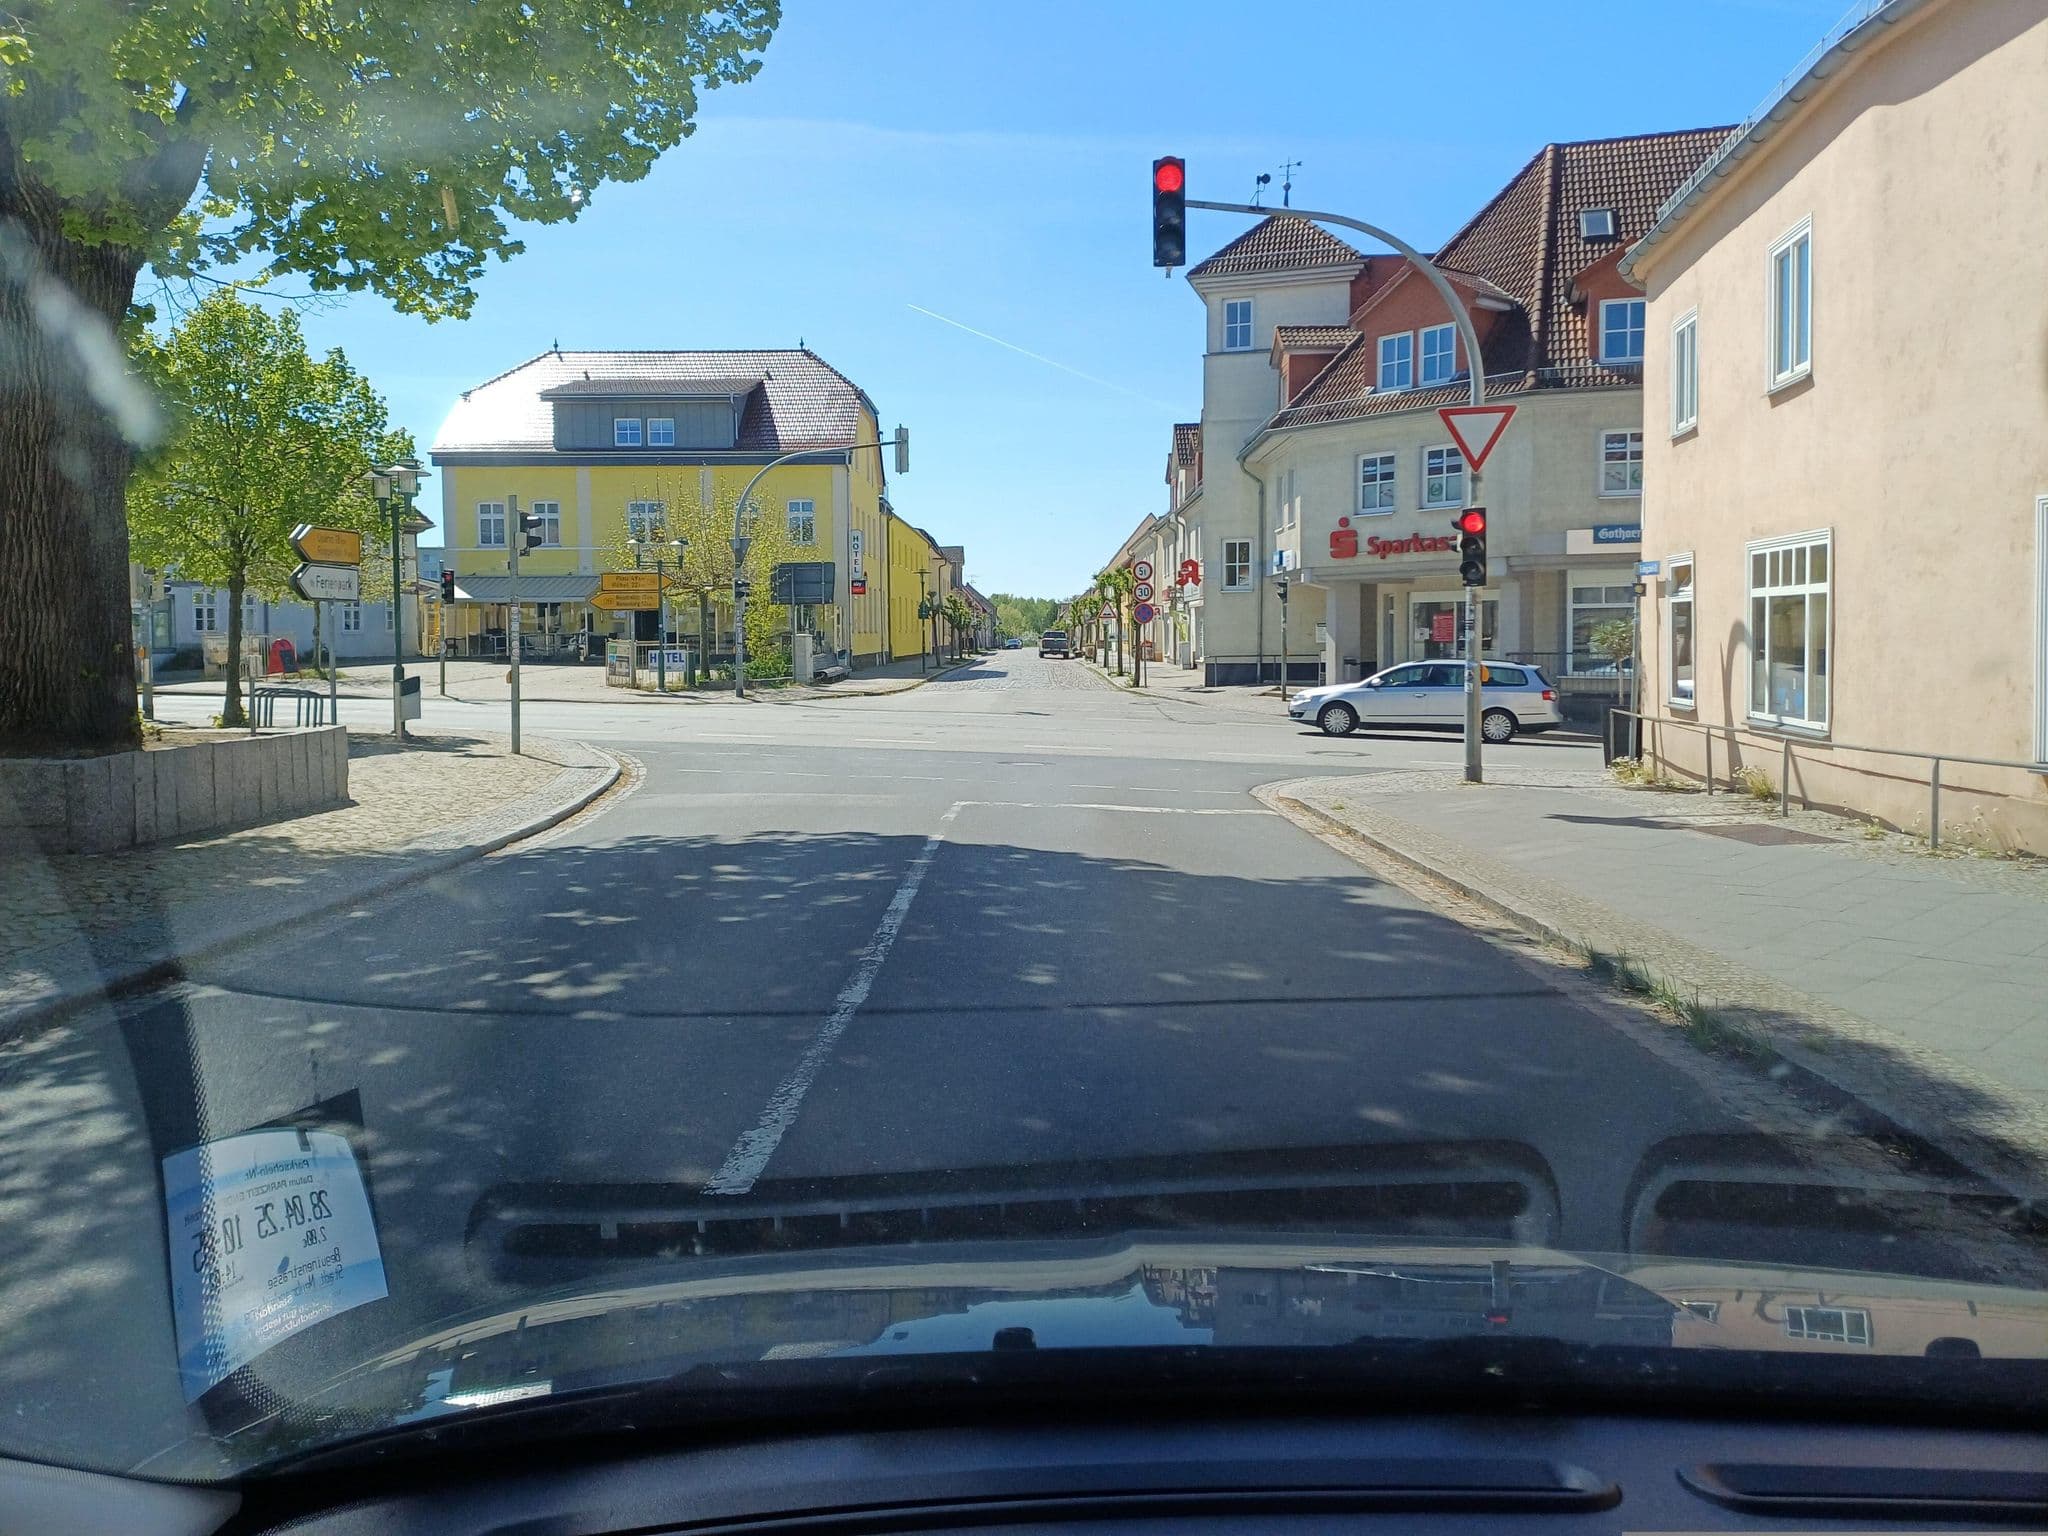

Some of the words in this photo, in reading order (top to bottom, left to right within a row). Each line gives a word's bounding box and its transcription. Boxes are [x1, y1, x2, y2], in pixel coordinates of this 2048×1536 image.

[852, 535, 860, 573] HOTEL
[1367, 532, 1457, 559] Sparkas
[316, 575, 353, 592] Ferienpark
[1138, 587, 1150, 597] 30
[649, 653, 685, 664] HTEL
